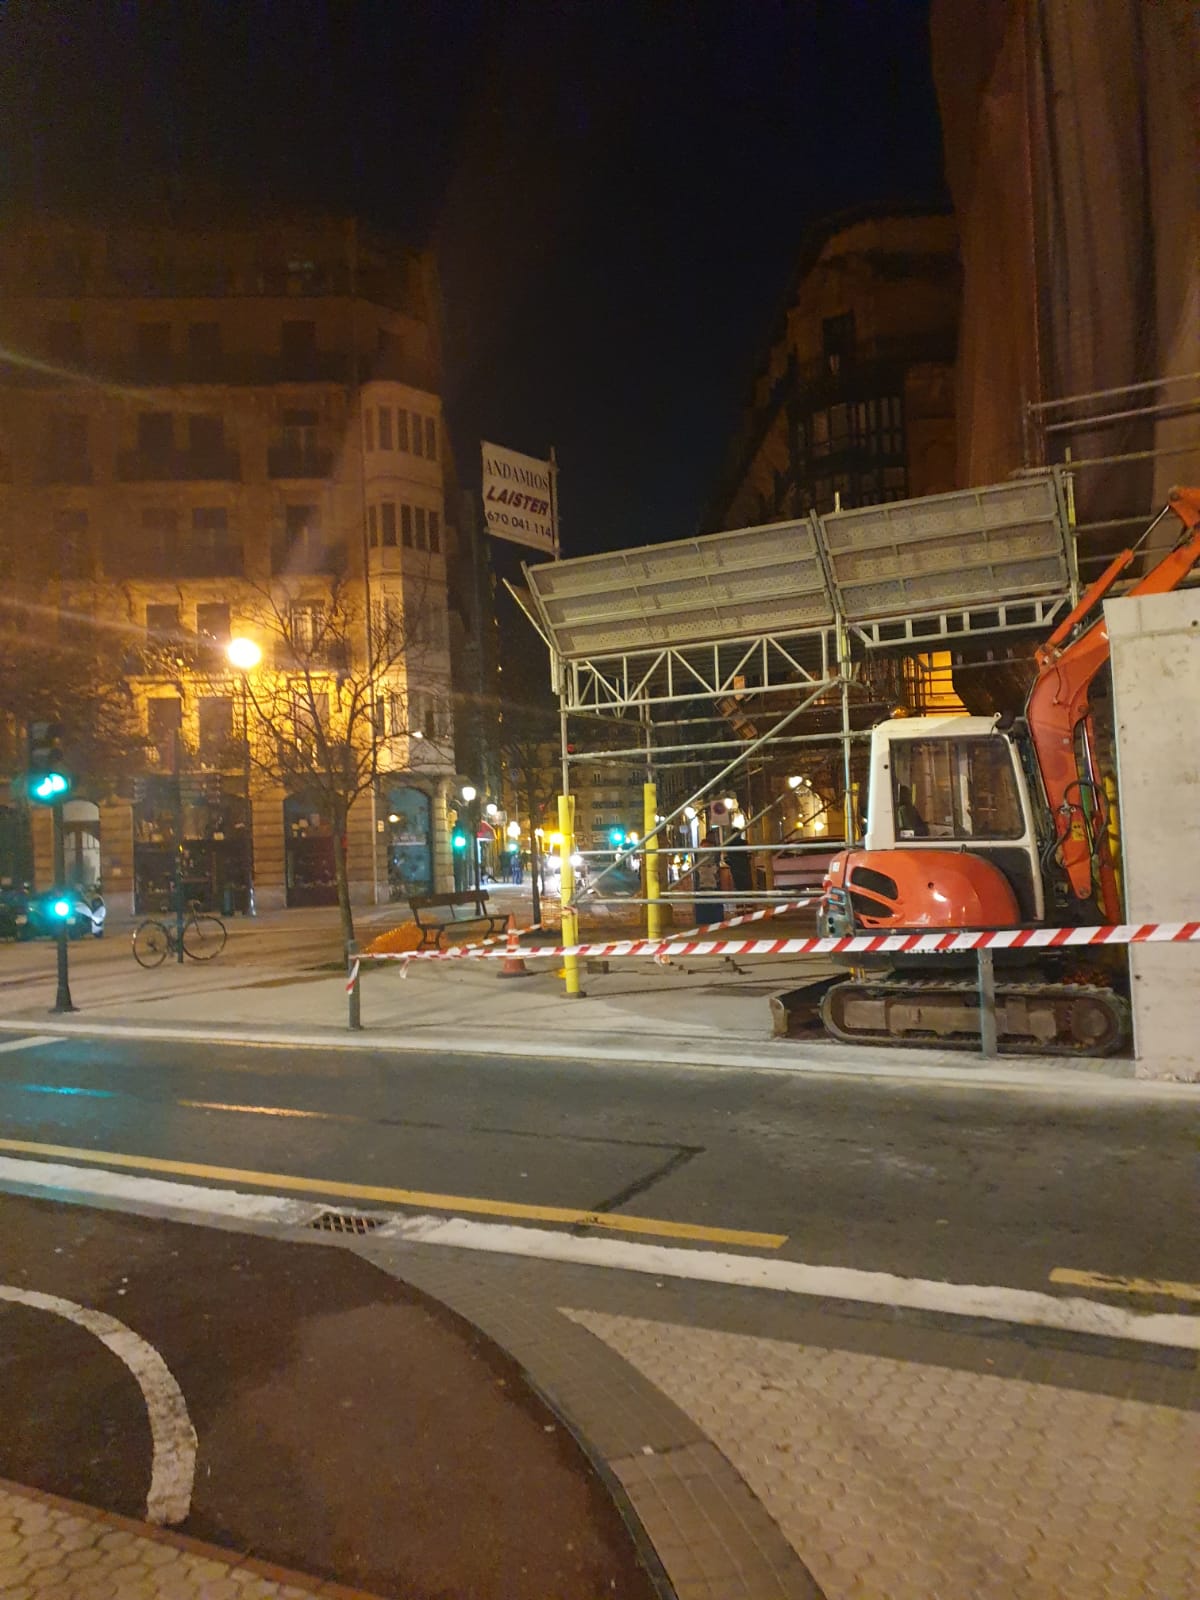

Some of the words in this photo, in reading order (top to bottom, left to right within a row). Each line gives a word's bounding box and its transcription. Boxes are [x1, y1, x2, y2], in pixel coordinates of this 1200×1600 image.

[486, 459, 549, 490] ANDAMIOS
[486, 485, 549, 516] LAISTER
[487, 511, 509, 525] 670
[511, 517, 530, 531] 041
